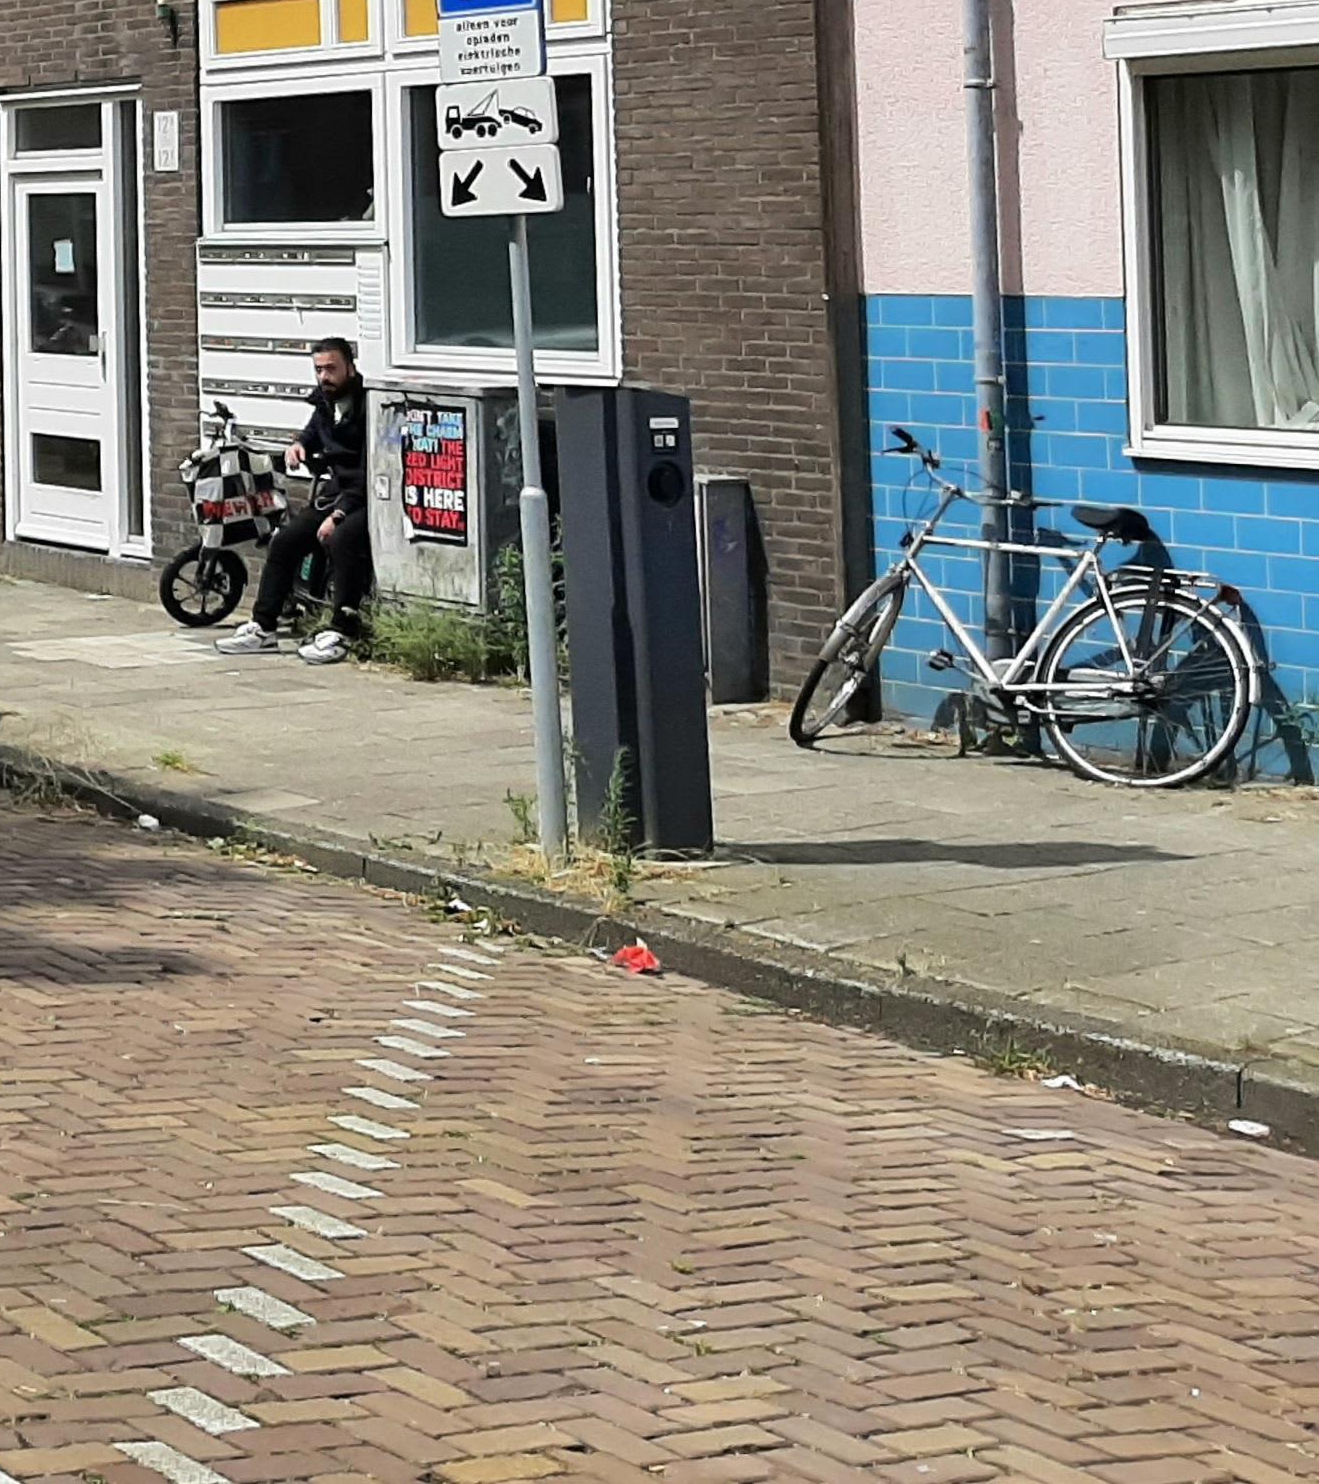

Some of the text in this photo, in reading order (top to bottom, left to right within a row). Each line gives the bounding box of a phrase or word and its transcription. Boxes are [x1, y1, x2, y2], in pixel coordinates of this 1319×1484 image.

[466, 33, 510, 46] opladen
[441, 439, 463, 455] THE
[430, 454, 462, 471] LIGHT
[423, 486, 465, 511] HERE
